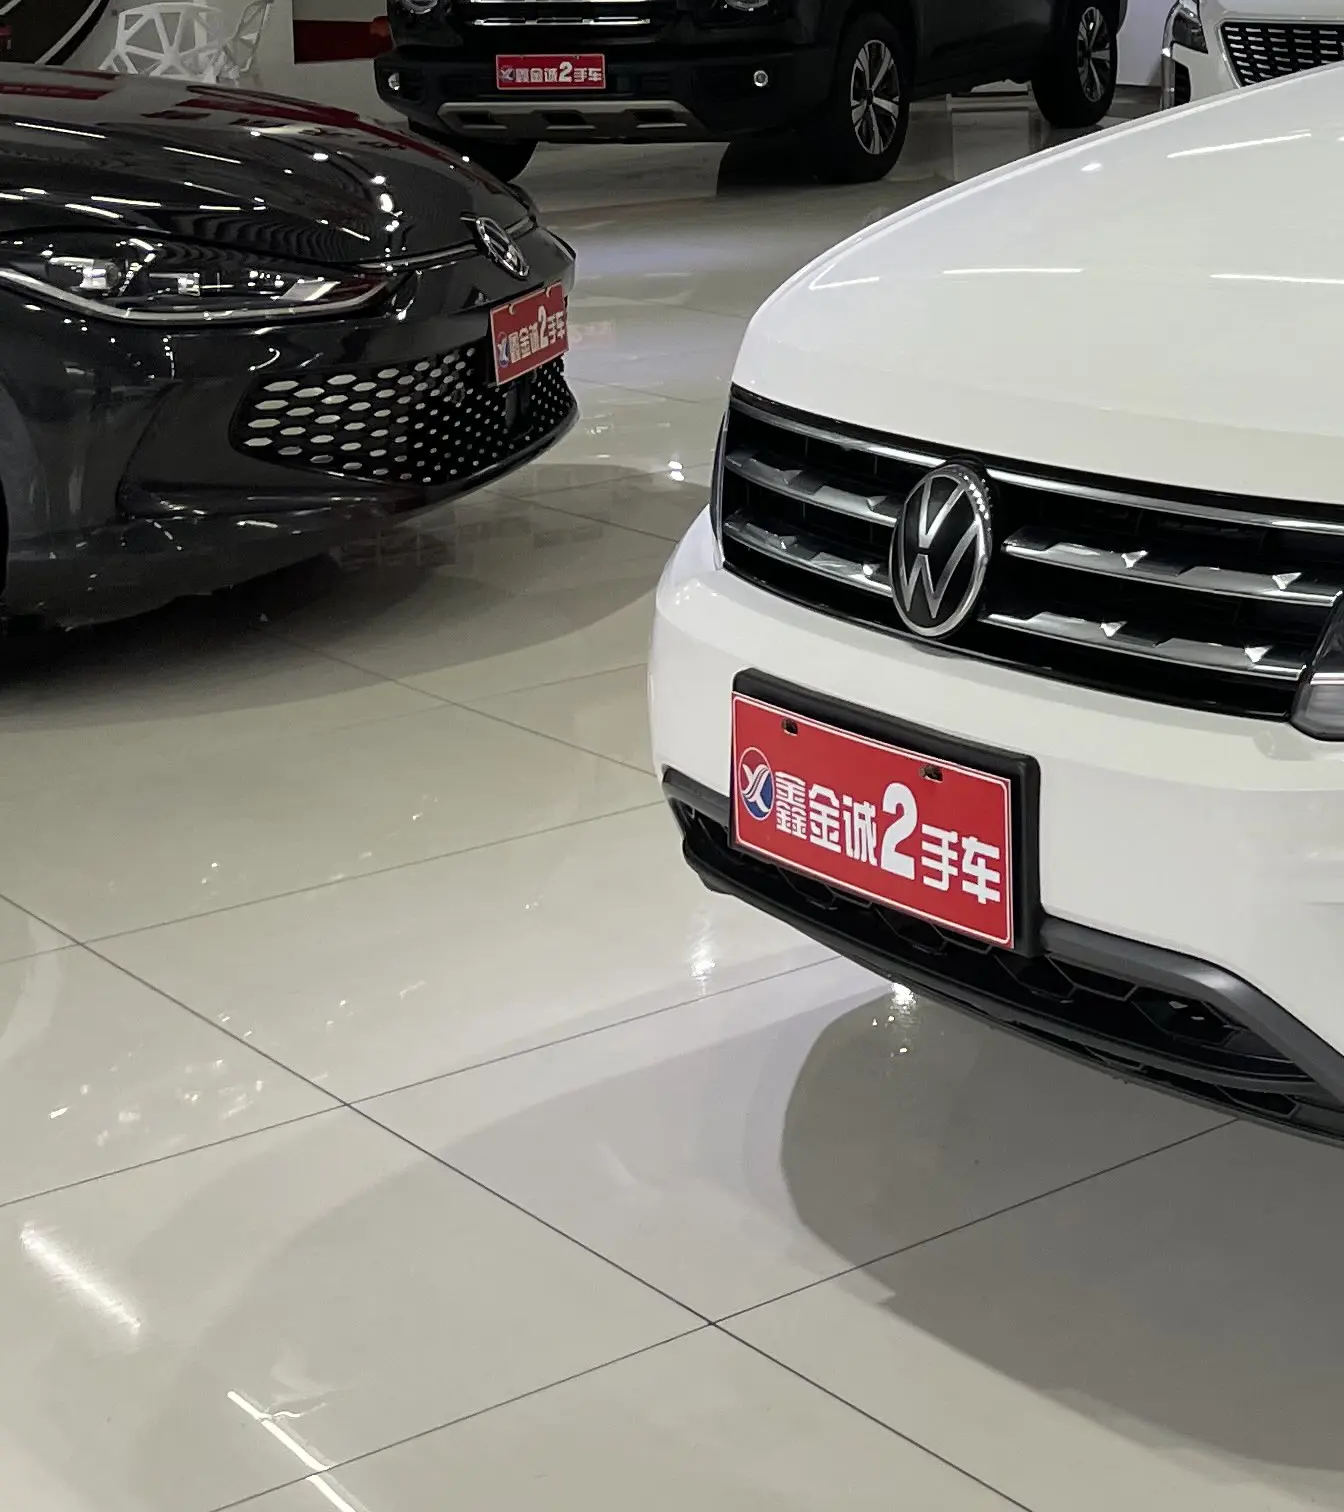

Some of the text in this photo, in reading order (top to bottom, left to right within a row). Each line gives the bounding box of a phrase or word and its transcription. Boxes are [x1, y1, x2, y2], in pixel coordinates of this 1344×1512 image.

[774, 771, 1001, 905] 鑫金诚2手车
